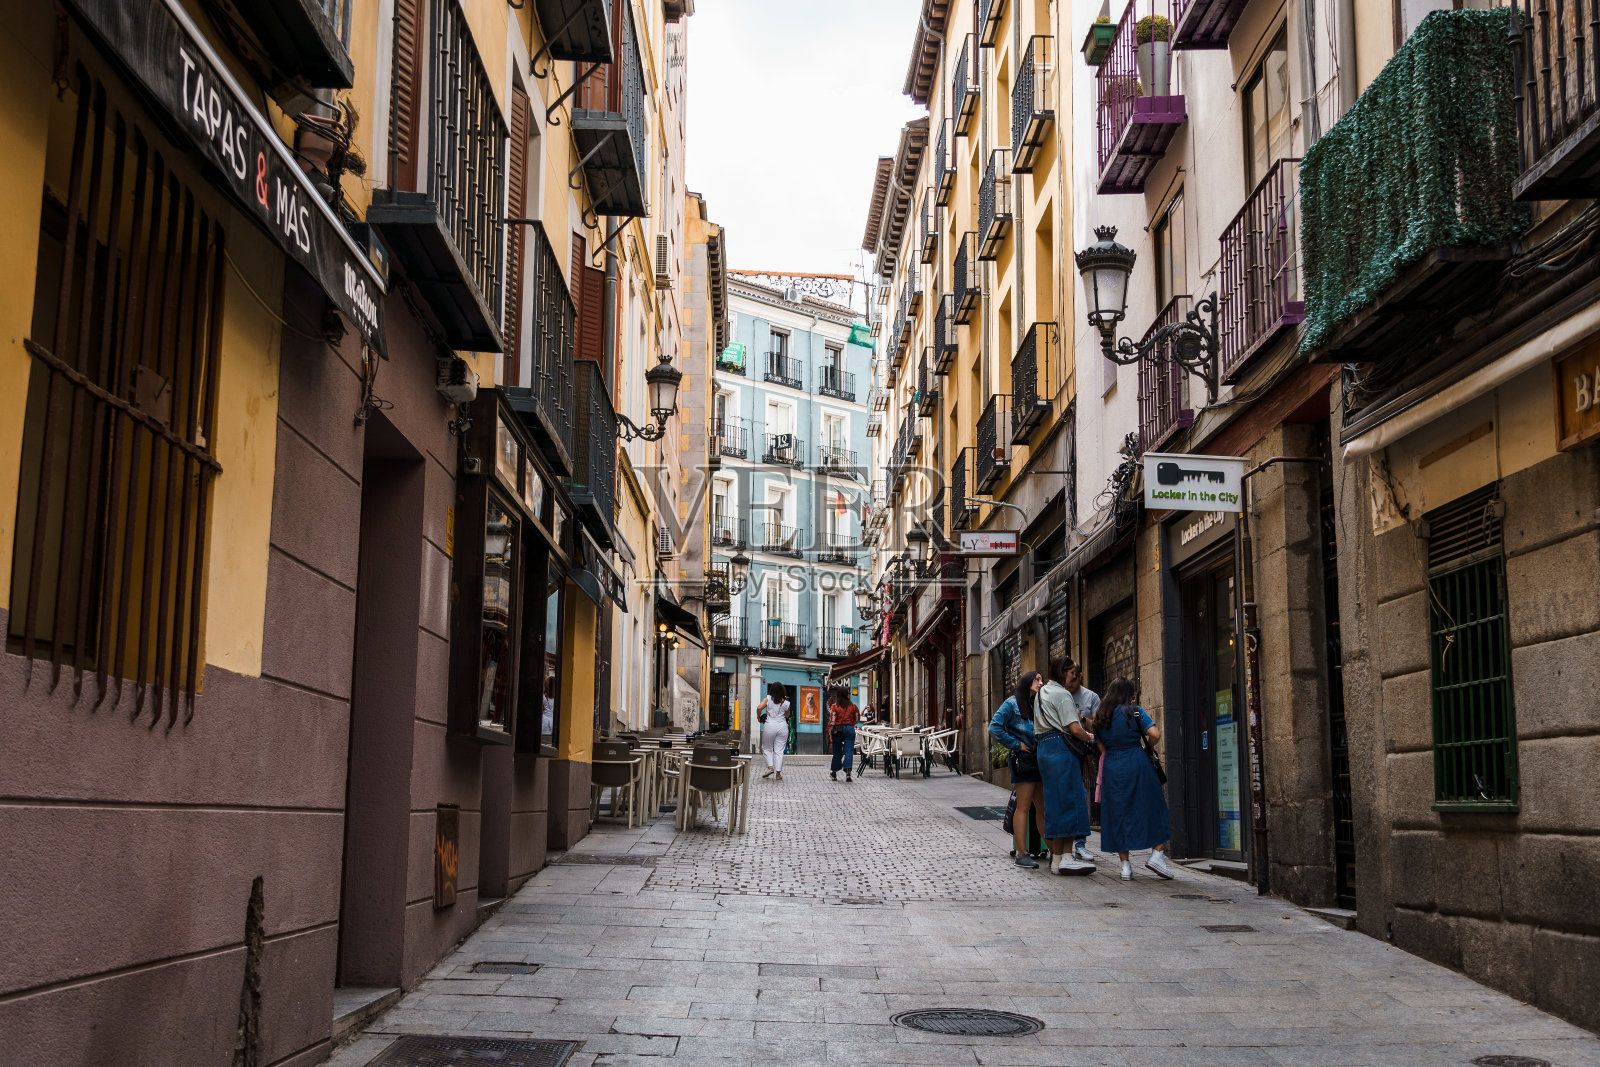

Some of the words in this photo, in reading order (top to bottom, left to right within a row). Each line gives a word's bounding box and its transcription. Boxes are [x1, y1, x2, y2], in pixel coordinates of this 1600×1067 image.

[179, 46, 248, 180] TAPAS
[256, 151, 269, 210] &
[276, 176, 311, 254] MÁS
[1152, 489, 1186, 500] Locker
[1188, 490, 1197, 501] in
[1199, 491, 1216, 502] the
[1218, 492, 1239, 504] City
[1181, 523, 1198, 546] Locker
